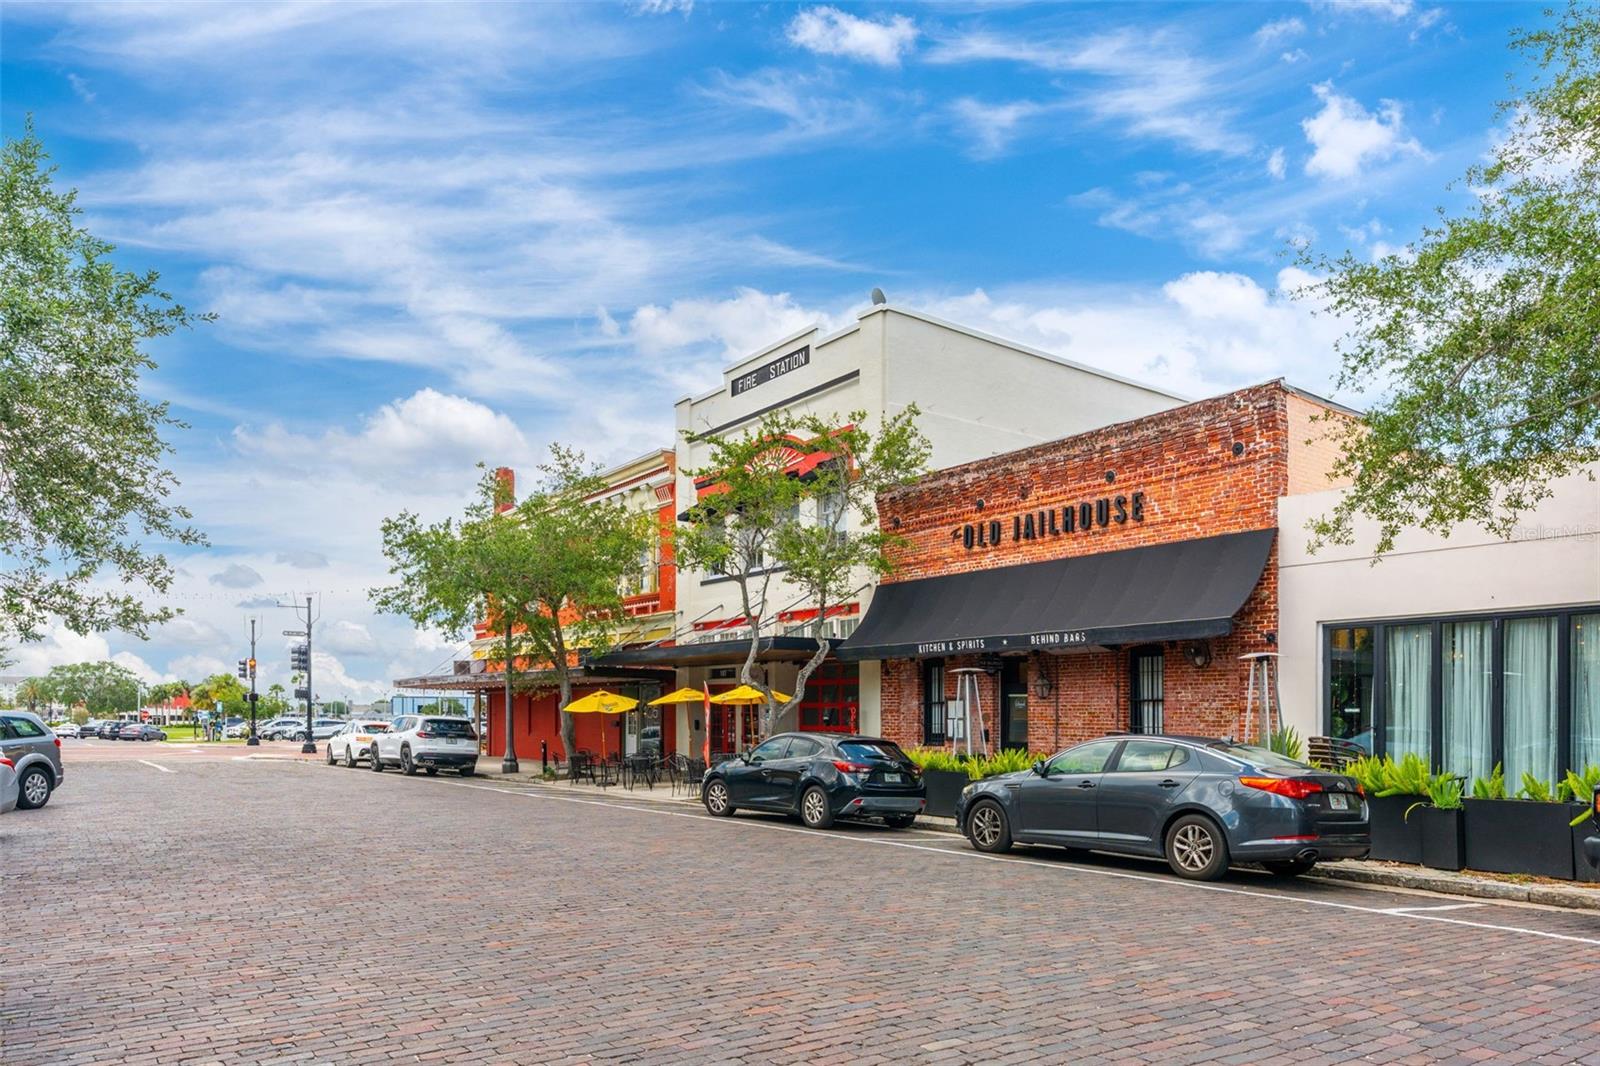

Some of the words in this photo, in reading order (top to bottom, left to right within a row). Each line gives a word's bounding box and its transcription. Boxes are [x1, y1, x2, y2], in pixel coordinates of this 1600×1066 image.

[738, 373, 758, 393] FIRE
[769, 351, 806, 379] STATION
[963, 520, 1001, 549] OLD
[1013, 492, 1145, 541] JAILHOUSE
[918, 642, 946, 654] KITCHEN
[956, 639, 985, 650] SPIRITS
[1030, 633, 1060, 645] BEHIND
